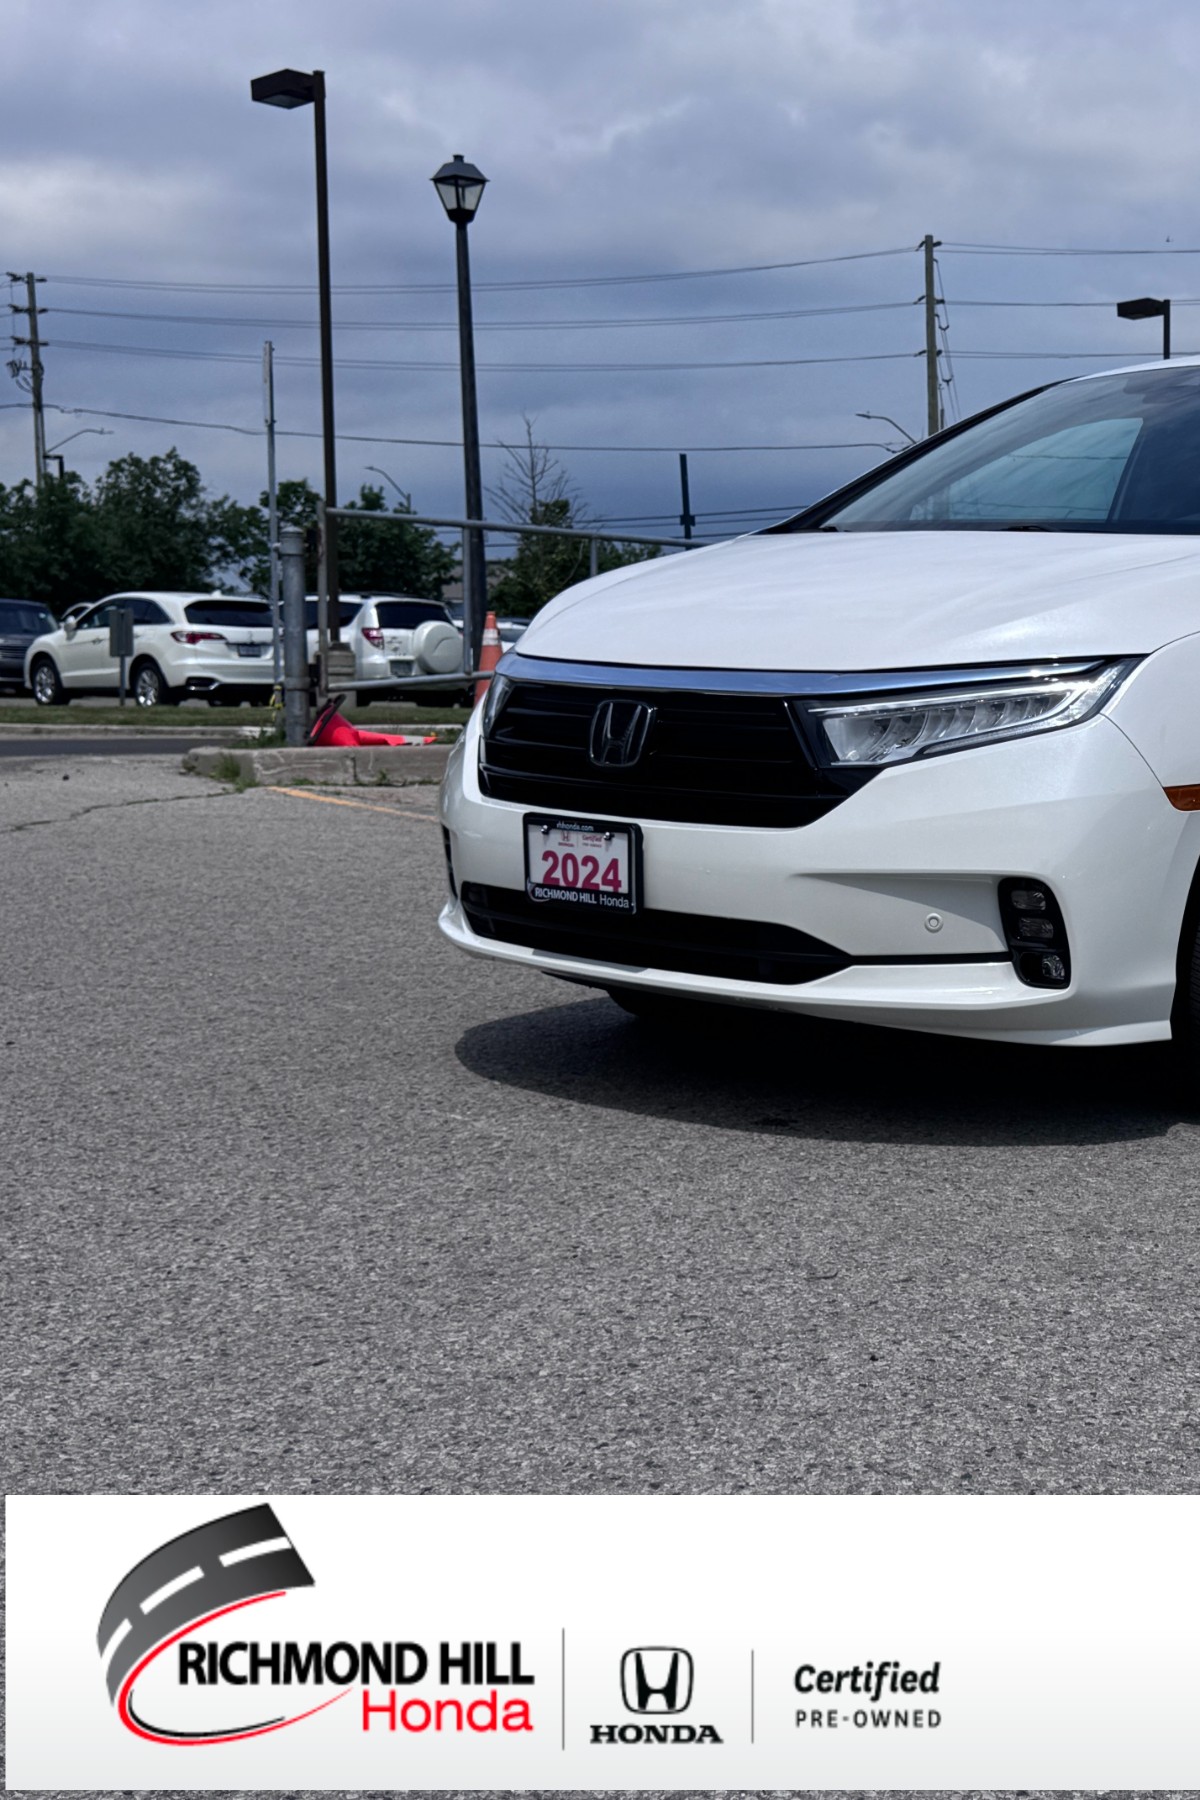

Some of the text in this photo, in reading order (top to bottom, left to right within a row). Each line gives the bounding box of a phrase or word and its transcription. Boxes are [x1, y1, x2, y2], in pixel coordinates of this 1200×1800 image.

[541, 850, 622, 893] 2024
[534, 886, 630, 909] RICHMOND HILL Honda
